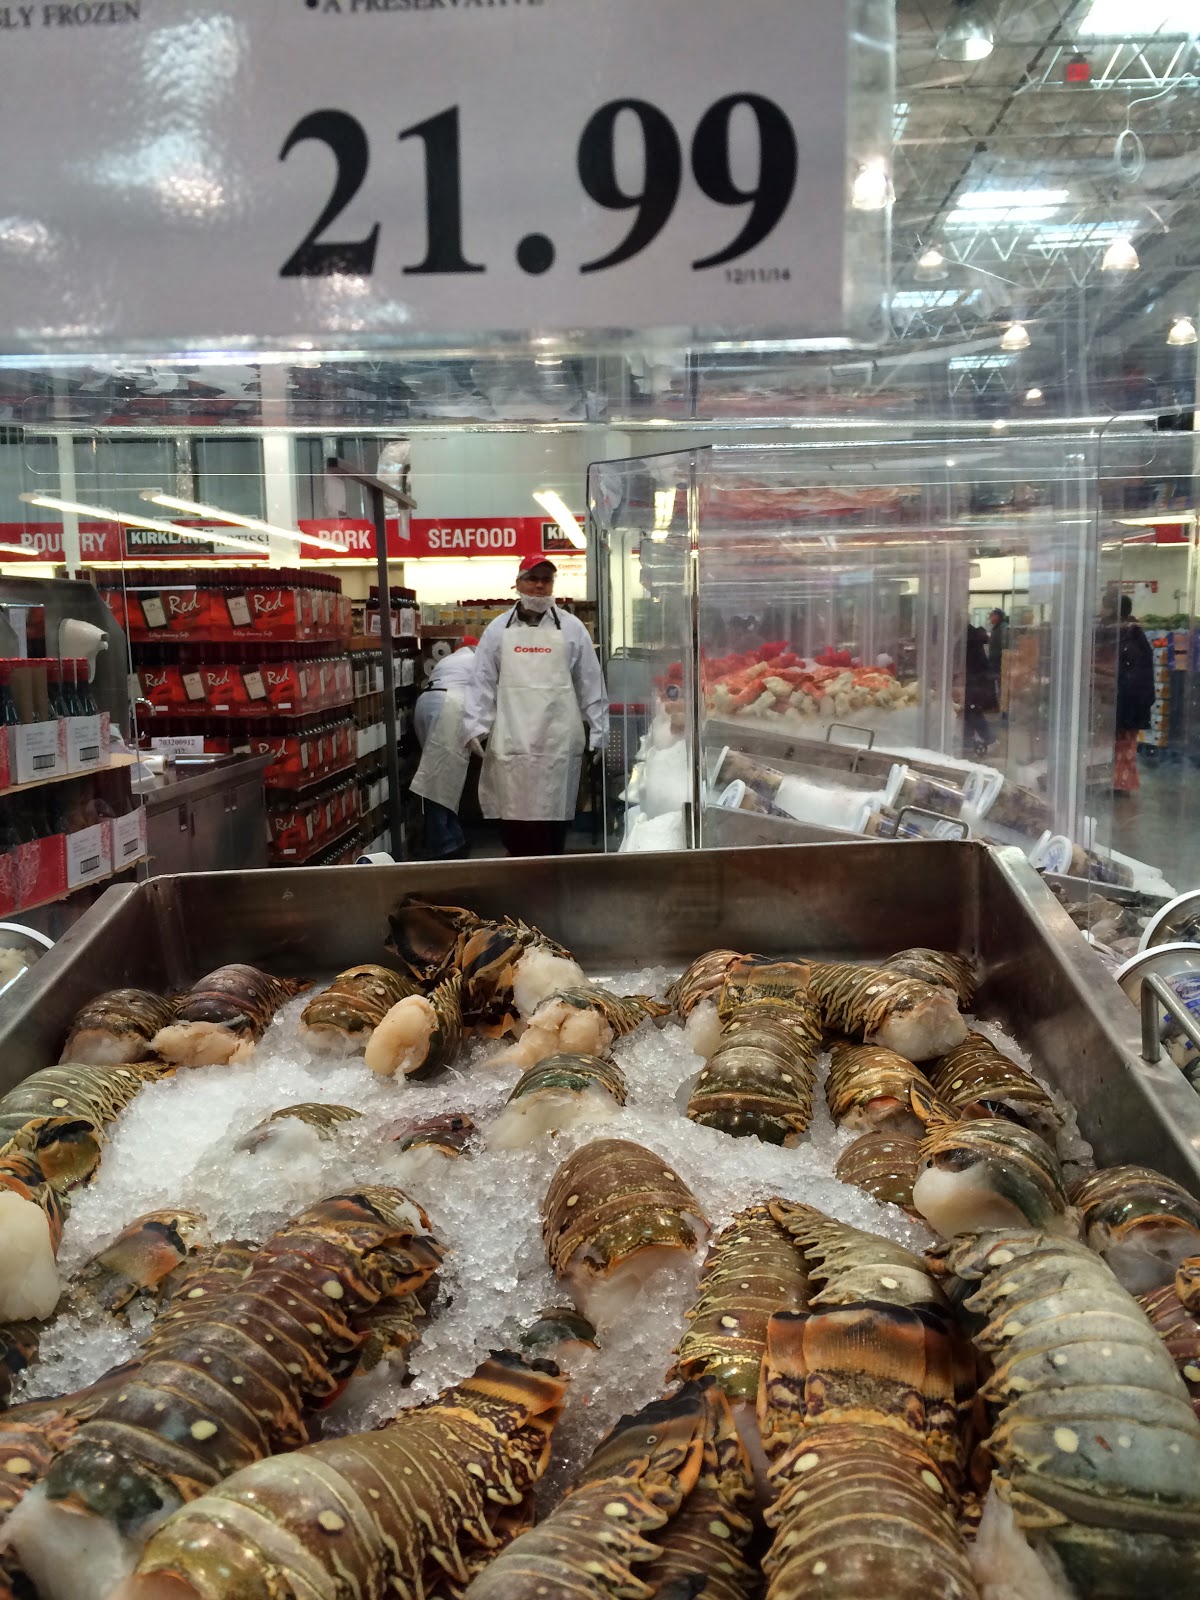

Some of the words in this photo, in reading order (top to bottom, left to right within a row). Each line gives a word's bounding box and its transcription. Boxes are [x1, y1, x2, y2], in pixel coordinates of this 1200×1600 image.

[42, 0, 142, 27] FROZEN
[278, 92, 798, 276] 21.99
[21, 533, 106, 553] POURY
[318, 529, 371, 549] PORK
[428, 528, 517, 549] SEAFOOD
[168, 591, 200, 615] Red
[253, 591, 285, 614] Red
[144, 671, 168, 688] Red
[207, 669, 230, 687] Red
[267, 668, 290, 685] Red
[275, 815, 296, 831] Red
